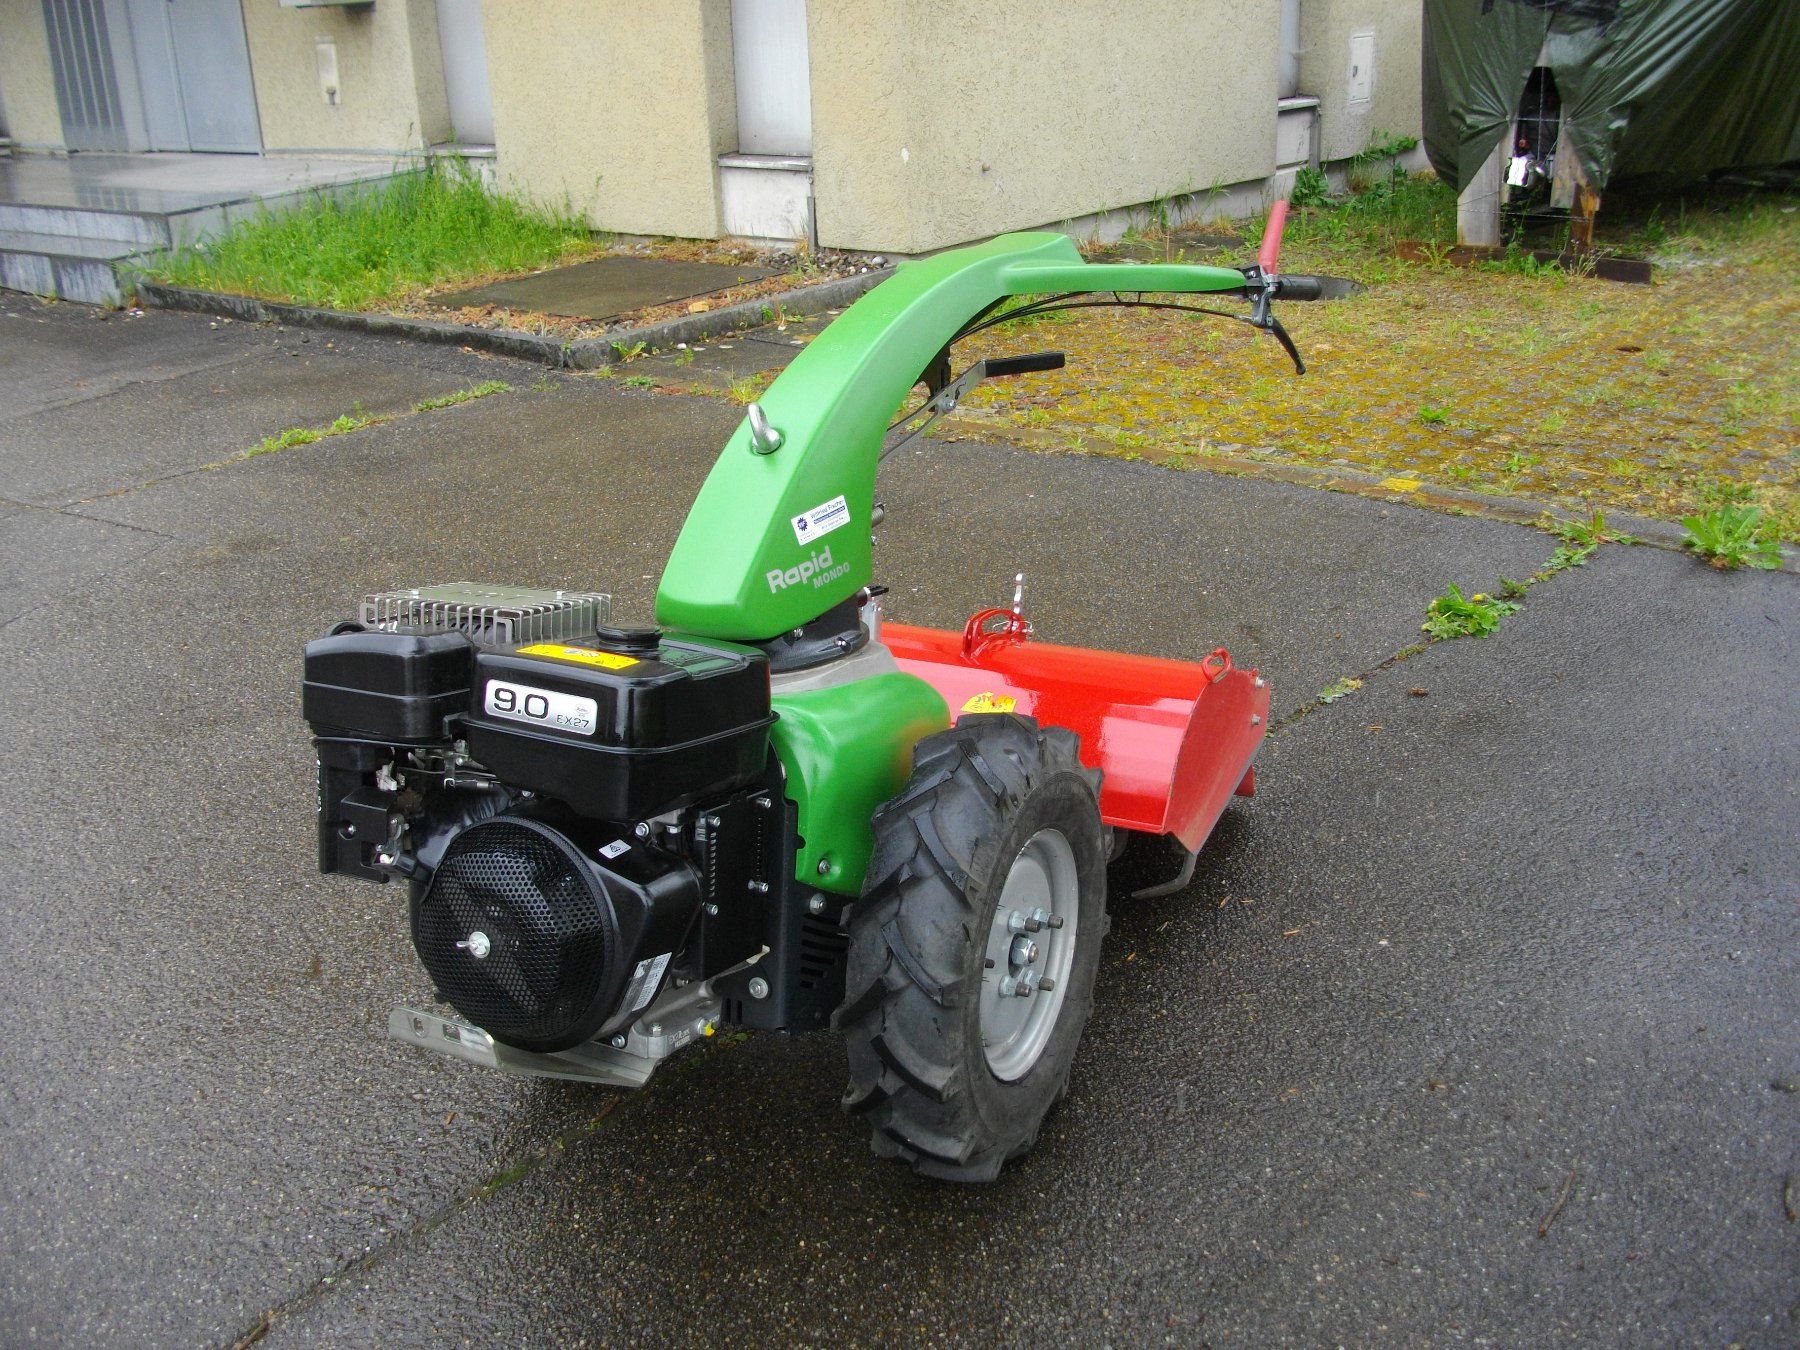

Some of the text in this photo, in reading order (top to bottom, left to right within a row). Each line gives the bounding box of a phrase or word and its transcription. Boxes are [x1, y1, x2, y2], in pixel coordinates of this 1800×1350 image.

[766, 544, 833, 594] Rapid
[813, 562, 850, 589] MONDO
[493, 687, 590, 728] 9.0 EX27
